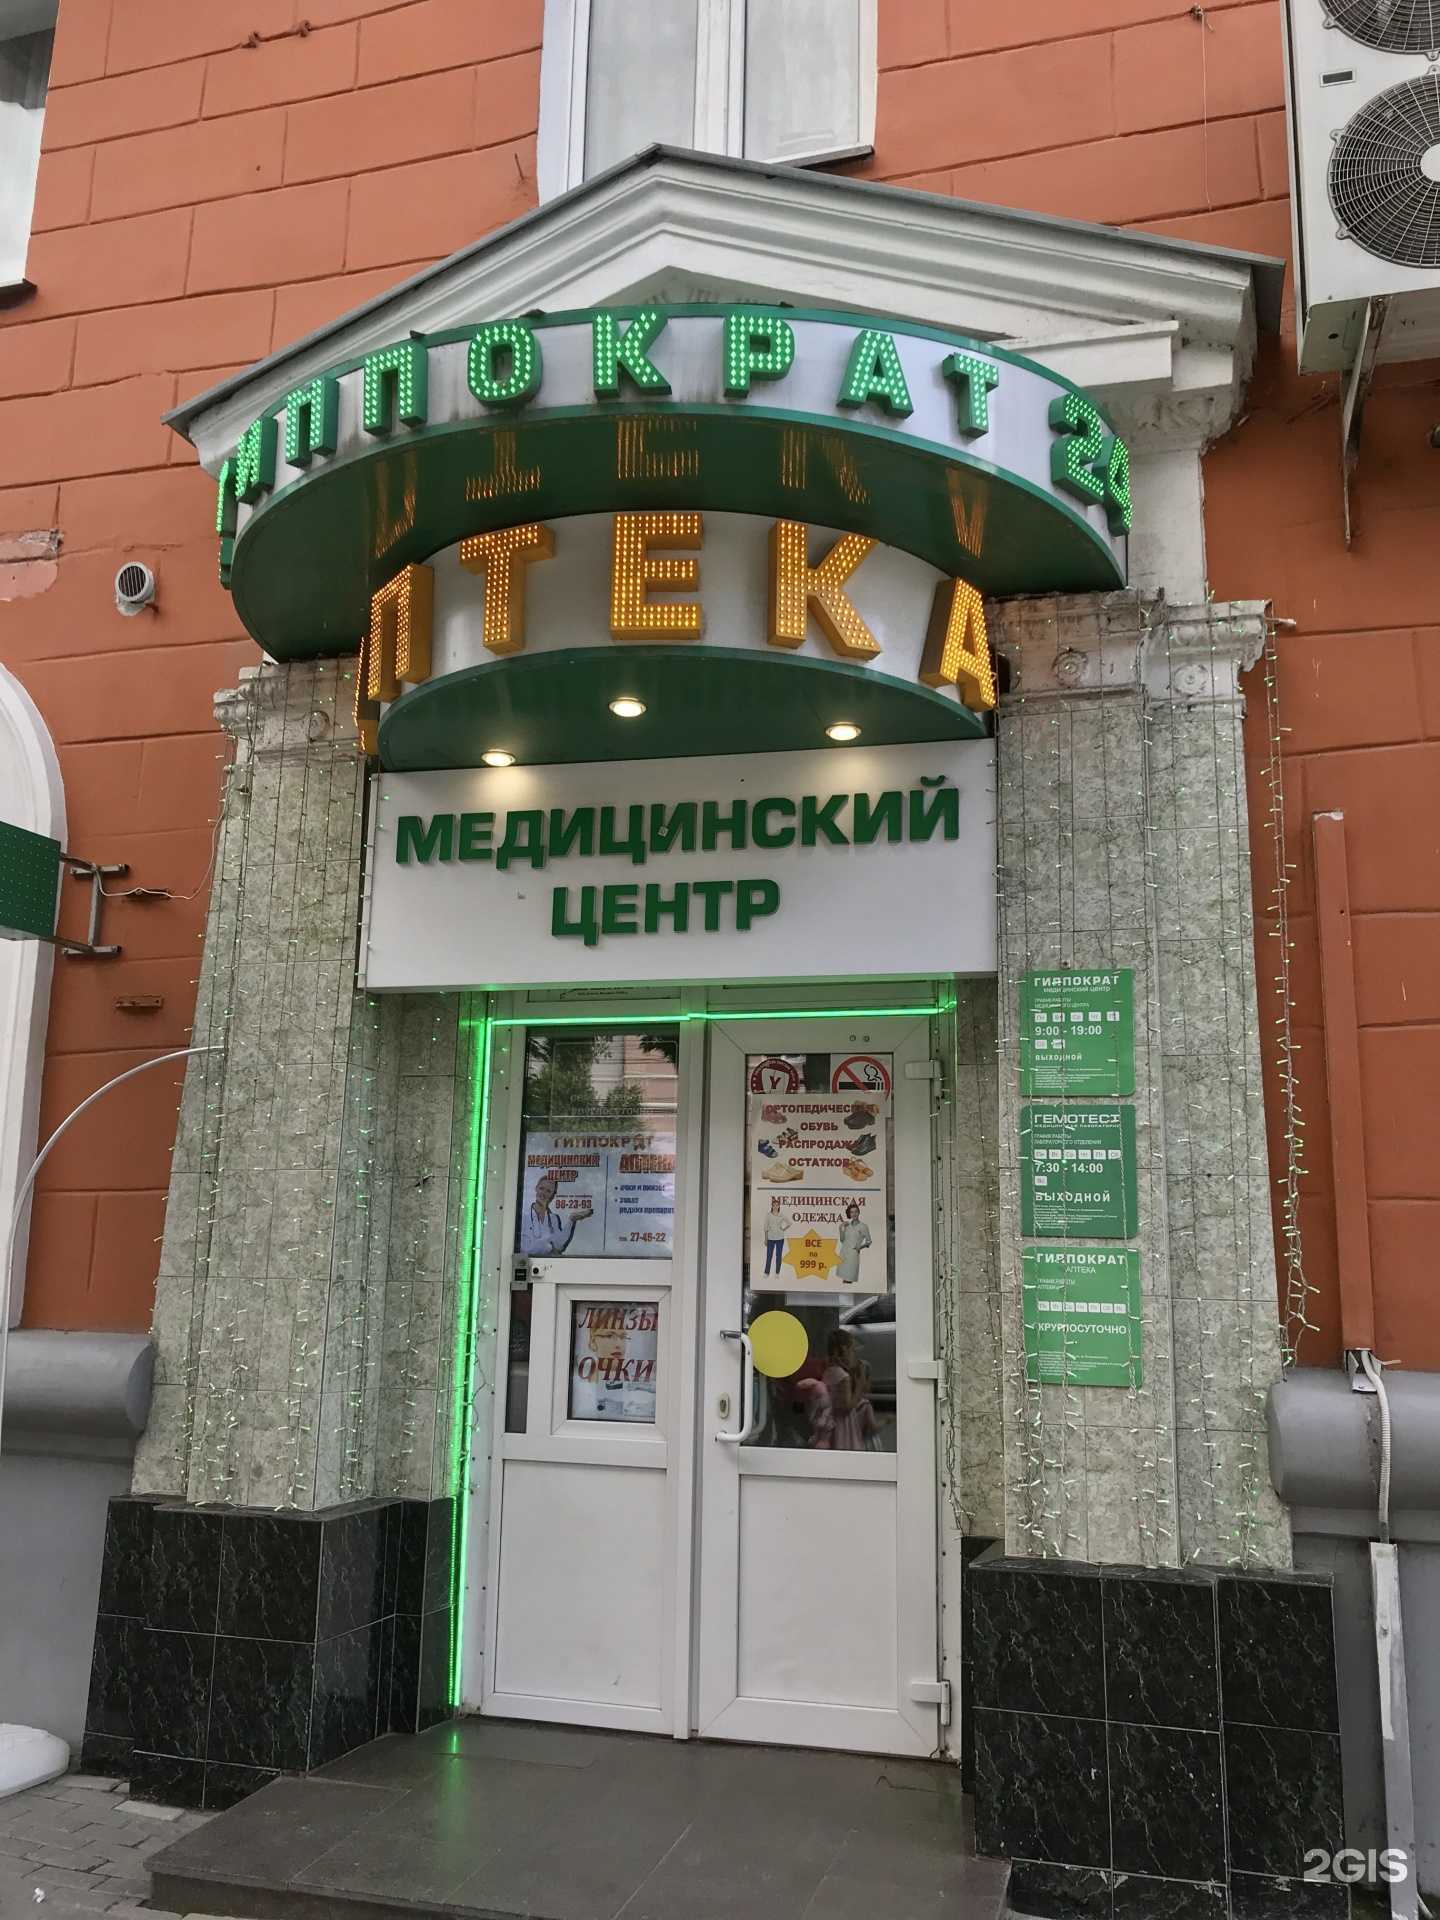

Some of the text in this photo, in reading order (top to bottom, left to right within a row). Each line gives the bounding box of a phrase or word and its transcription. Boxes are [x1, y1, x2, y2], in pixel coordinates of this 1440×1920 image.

[215, 308, 1134, 537] ИППОКРАТ 24
[353, 510, 997, 758] ПТЕКА
[396, 774, 960, 870] МЕДИЦИНСКИЙ
[551, 878, 781, 946] ЦЕНТР
[1035, 1026, 1059, 1036] 9:00
[1070, 1025, 1102, 1036] 19:00
[800, 1121, 839, 1132] ОБУВЬ
[788, 1158, 850, 1168] ОСТАТКОВ
[1034, 1162, 1060, 1173] 7:30
[1071, 1163, 1103, 1173] 14:00
[771, 1196, 866, 1207] МЕДИЦИНСКАЯ
[1035, 1190, 1111, 1204] ВЫХОДНОЙ
[792, 1212, 844, 1224] ОДЕЖДА
[804, 1238, 823, 1249] ВСЕ
[800, 1259, 817, 1269] 999
[578, 1307, 659, 1331] ЛИНЗЫ
[577, 1356, 654, 1383] ОЧКИ
